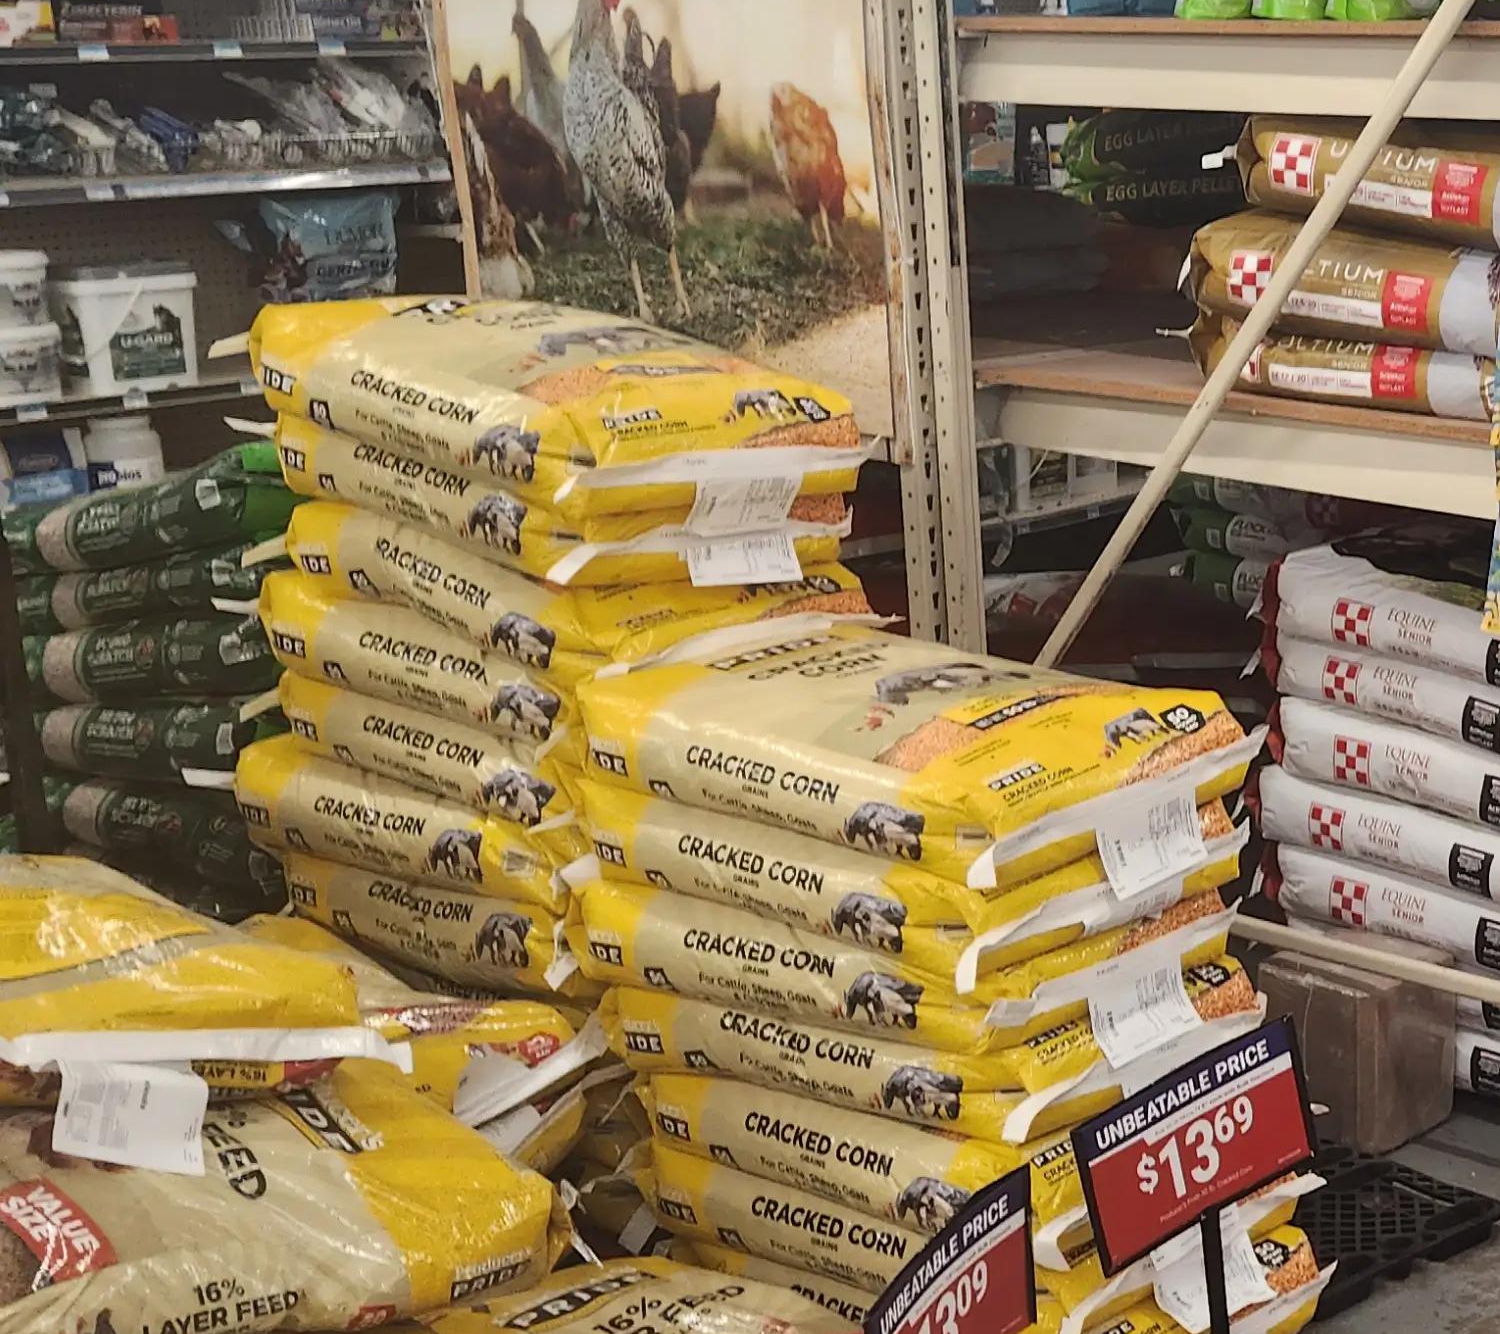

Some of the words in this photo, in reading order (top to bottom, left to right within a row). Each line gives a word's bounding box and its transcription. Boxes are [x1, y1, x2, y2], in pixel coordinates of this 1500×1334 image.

[1104, 131, 1133, 152] EGG
[1106, 183, 1137, 202] EGG
[1142, 179, 1188, 199] LAYER
[350, 370, 427, 408] CRACKED
[428, 397, 481, 425] CORN
[353, 442, 424, 477] CRACKED
[424, 466, 472, 498] CORN
[443, 573, 491, 610] CORN
[1387, 607, 1436, 632] EQUINE
[1397, 628, 1433, 646] SENIOR
[359, 631, 438, 667] CRACKED
[1372, 664, 1420, 689] EQUINE
[1382, 685, 1415, 701] SENIOR
[363, 714, 434, 751] CRACKED
[436, 739, 485, 768] CORN
[1384, 743, 1432, 769] EQUINE
[686, 744, 776, 786] CRACKED
[779, 771, 840, 805] CORN
[1395, 763, 1429, 782] SENIOR
[314, 795, 382, 827] CRACKED
[382, 813, 426, 836] CORN
[1357, 813, 1403, 837] EQUINE
[1367, 832, 1400, 851] SENIOR
[677, 835, 765, 875] CRACKED
[767, 861, 825, 895] CORN
[433, 900, 474, 924] CORN
[1381, 886, 1427, 912] EQUINE
[1391, 908, 1425, 925] SENIOR
[683, 928, 775, 964] CRACKED
[779, 948, 836, 979] CORN
[698, 971, 715, 983] For
[716, 974, 750, 994] Cattle,
[751, 982, 786, 1003] Sheep,
[787, 992, 817, 1007] Goats
[719, 1009, 811, 1055] CRACKED
[814, 1037, 876, 1070] CORN
[1095, 1073, 1212, 1151] UNBEATABLE
[1214, 1038, 1270, 1084] PRICE
[744, 1111, 832, 1155] CRACKED
[835, 1141, 894, 1178] CORN
[843, 1186, 871, 1204] Goats
[0, 1194, 57, 1244] SIZE
[26, 1185, 100, 1256] VALUE
[751, 1195, 844, 1239] CRACKED
[847, 1223, 908, 1260] CORN
[961, 1193, 1009, 1247] PRICE
[192, 1278, 246, 1307] 16%
[236, 1289, 299, 1323] FEED
